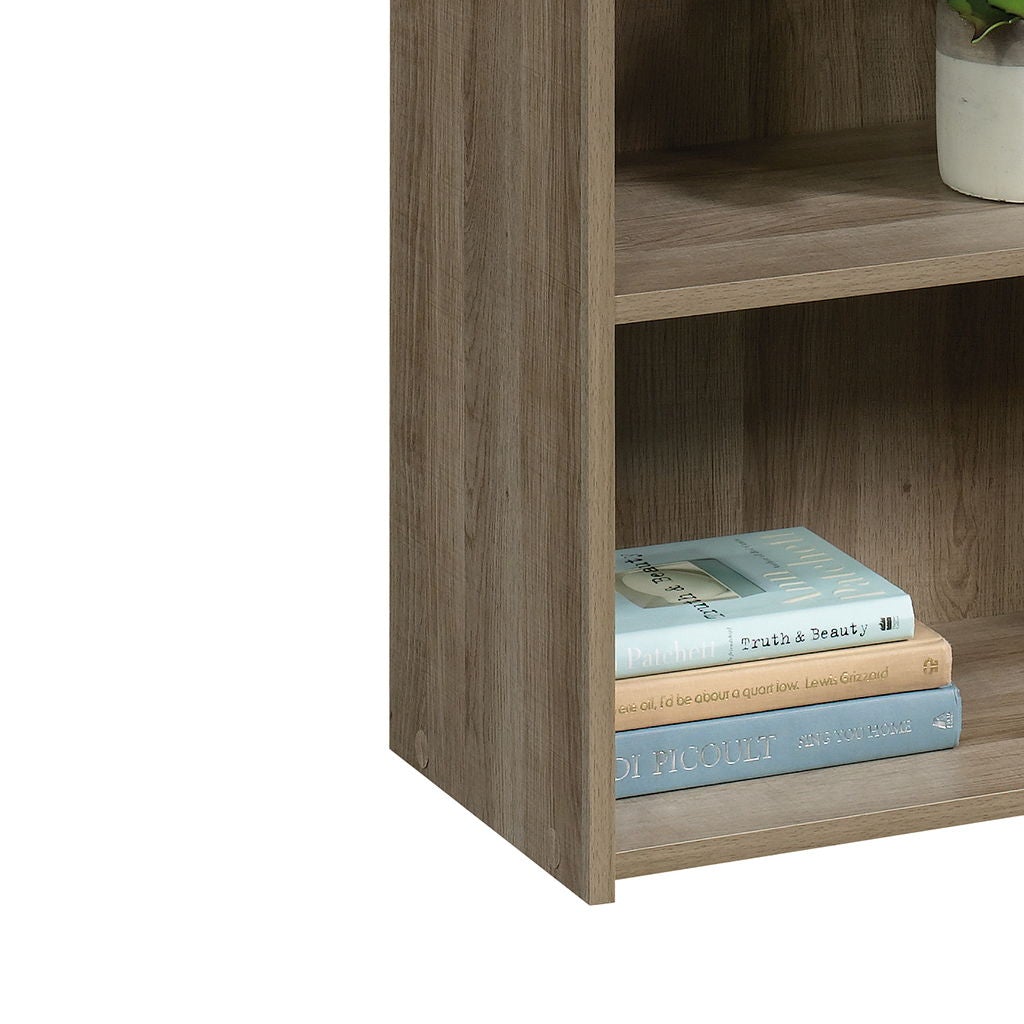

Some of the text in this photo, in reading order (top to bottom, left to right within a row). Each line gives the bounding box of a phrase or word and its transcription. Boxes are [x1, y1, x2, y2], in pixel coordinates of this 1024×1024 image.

[741, 621, 868, 651] Truth & Beauty
[627, 639, 715, 670] Patchett
[616, 703, 637, 714] ere
[676, 693, 692, 706] be
[694, 689, 729, 704] about
[731, 689, 740, 698] a
[742, 683, 773, 699] quart
[805, 674, 838, 689] Lewis
[839, 666, 889, 684] Grizzard
[798, 719, 912, 749] SING YOU HOME
[652, 734, 777, 776] PICOULT
